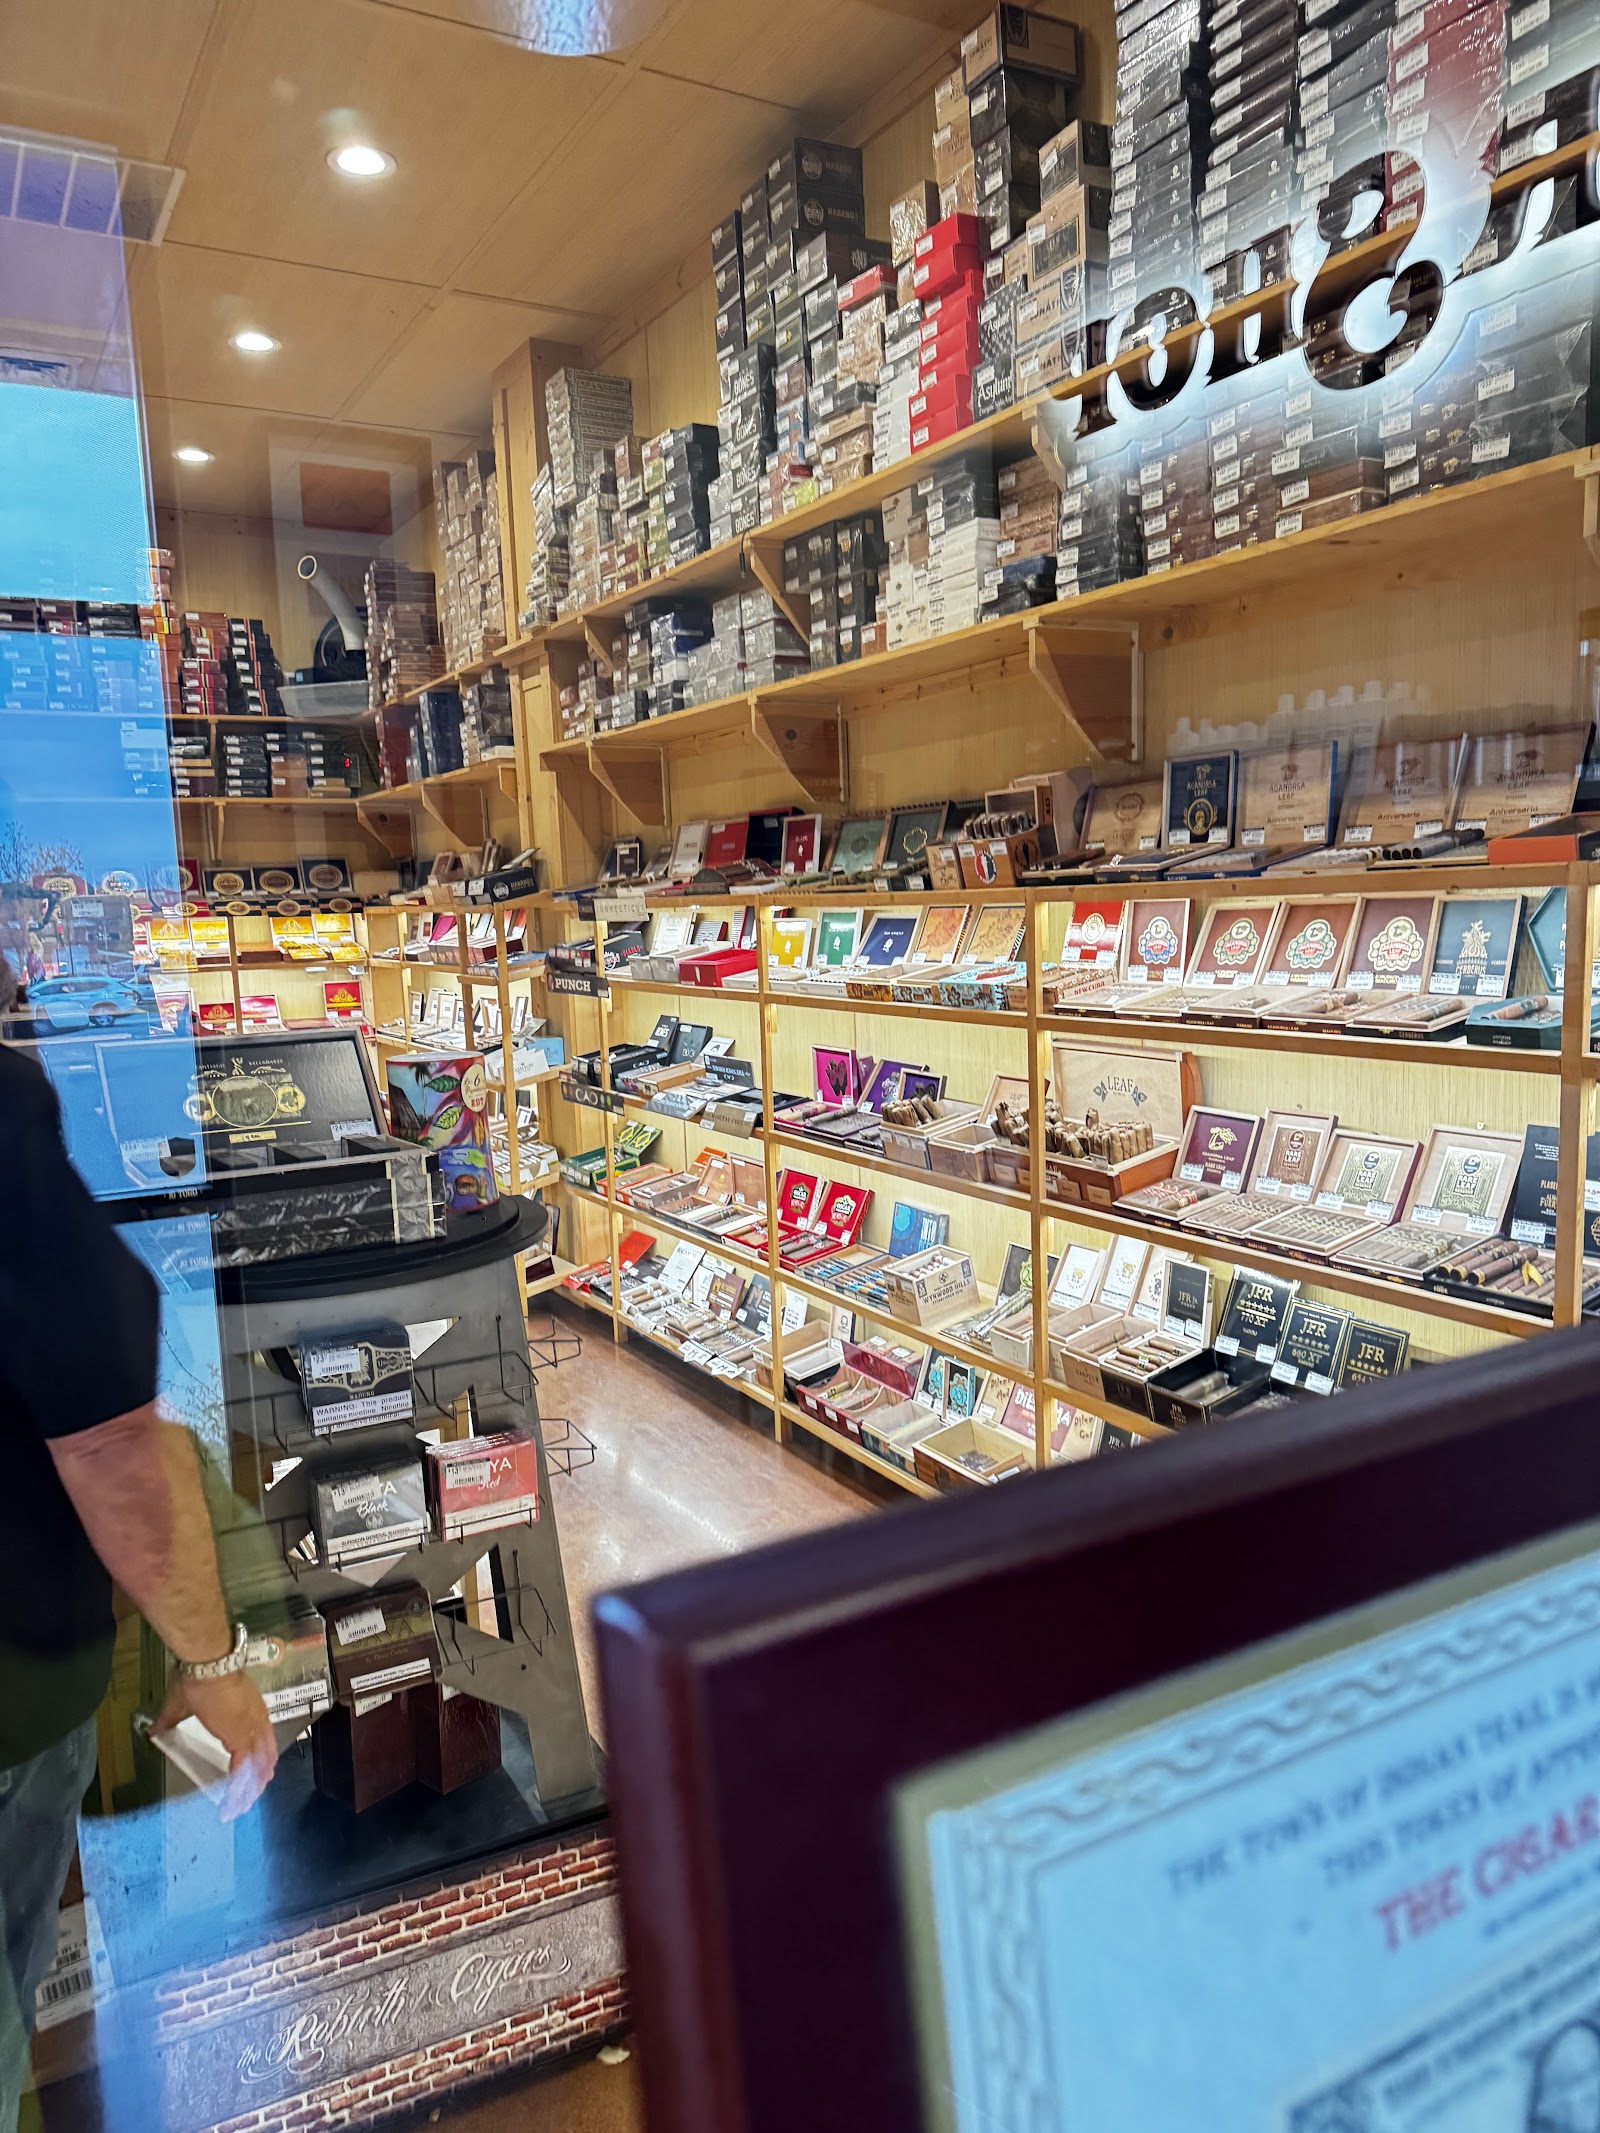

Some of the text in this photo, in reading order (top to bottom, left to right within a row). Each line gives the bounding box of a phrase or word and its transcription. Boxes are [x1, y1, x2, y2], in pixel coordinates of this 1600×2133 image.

[977, 375, 1012, 408] Asylum
[1269, 781, 1306, 794] AGANORSA
[1278, 793, 1294, 801] LEAF
[1377, 811, 1422, 822] Aniversario
[1488, 805, 1539, 817] Aniversario
[1454, 962, 1487, 977] CERBERUS
[554, 977, 591, 992] PUNCH
[473, 1073, 481, 1087] 6
[1106, 1075, 1134, 1094] LEAF
[574, 1089, 600, 1105] CAO
[1284, 1155, 1301, 1163] LEAF
[1285, 1149, 1303, 1158] RARE
[1356, 1177, 1375, 1186] LEAF
[1357, 1170, 1377, 1180] RARE
[1457, 1174, 1479, 1186] RARE
[1456, 1181, 1476, 1191] LEAF
[922, 1287, 954, 1305] WYNWOOD
[953, 1279, 972, 1293] HILLS
[1247, 1282, 1275, 1303] JFR
[1253, 1313, 1269, 1329] XT
[1299, 1318, 1328, 1339] JFR
[1307, 1352, 1323, 1366] XT
[1357, 1341, 1385, 1363] JFR
[316, 1393, 409, 1417] WARNING: This product
[381, 1402, 409, 1412] Nicotine
[477, 1476, 501, 1492] Red
[356, 1498, 390, 1521] Black
[1373, 1865, 1466, 1952] THE
[236, 1943, 572, 2070] the Rebirth Cigars
